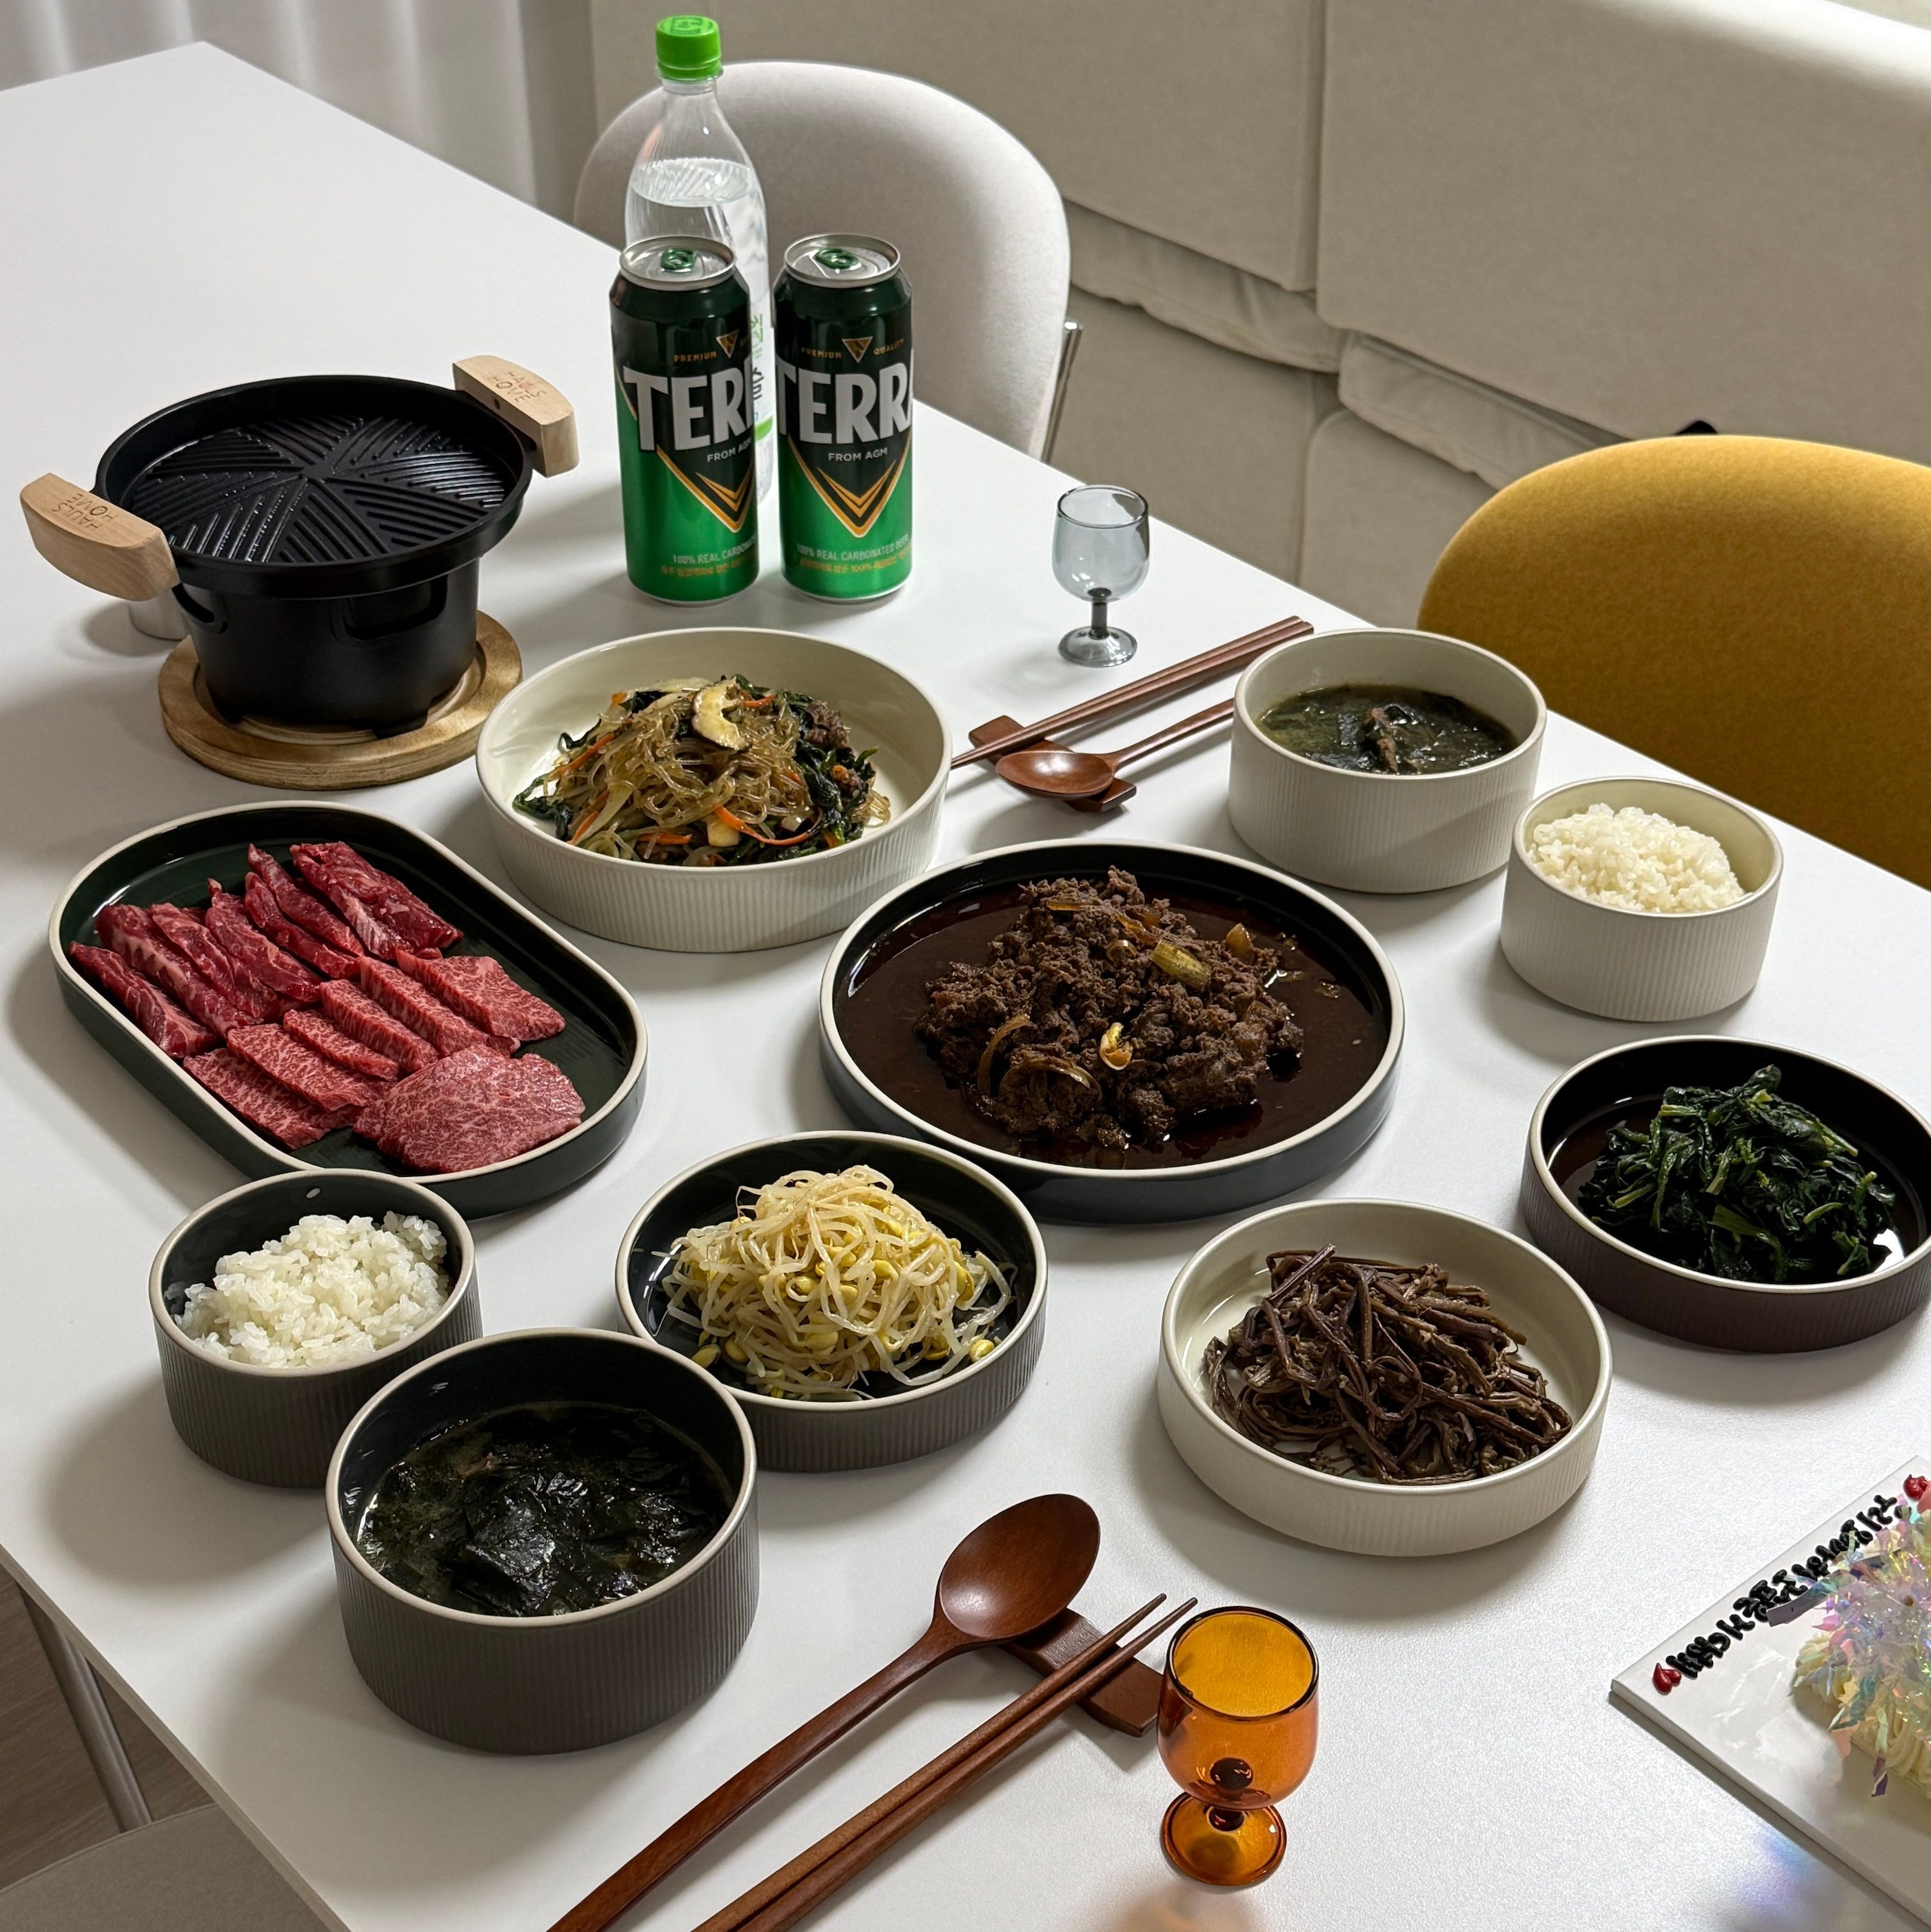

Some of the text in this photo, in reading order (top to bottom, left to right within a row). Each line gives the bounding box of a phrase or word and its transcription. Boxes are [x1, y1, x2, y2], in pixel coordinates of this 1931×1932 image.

[801, 347, 842, 359] PREMIUM
[873, 338, 904, 355] QUALITY
[674, 351, 717, 362] PREMIUM
[775, 358, 913, 444] TERR
[707, 447, 736, 462] FROM
[828, 447, 888, 462] FROM AGM
[673, 554, 695, 564] 100%
[698, 554, 720, 564] REAL
[817, 549, 839, 561] REAL
[841, 543, 895, 561] CARBONATED
